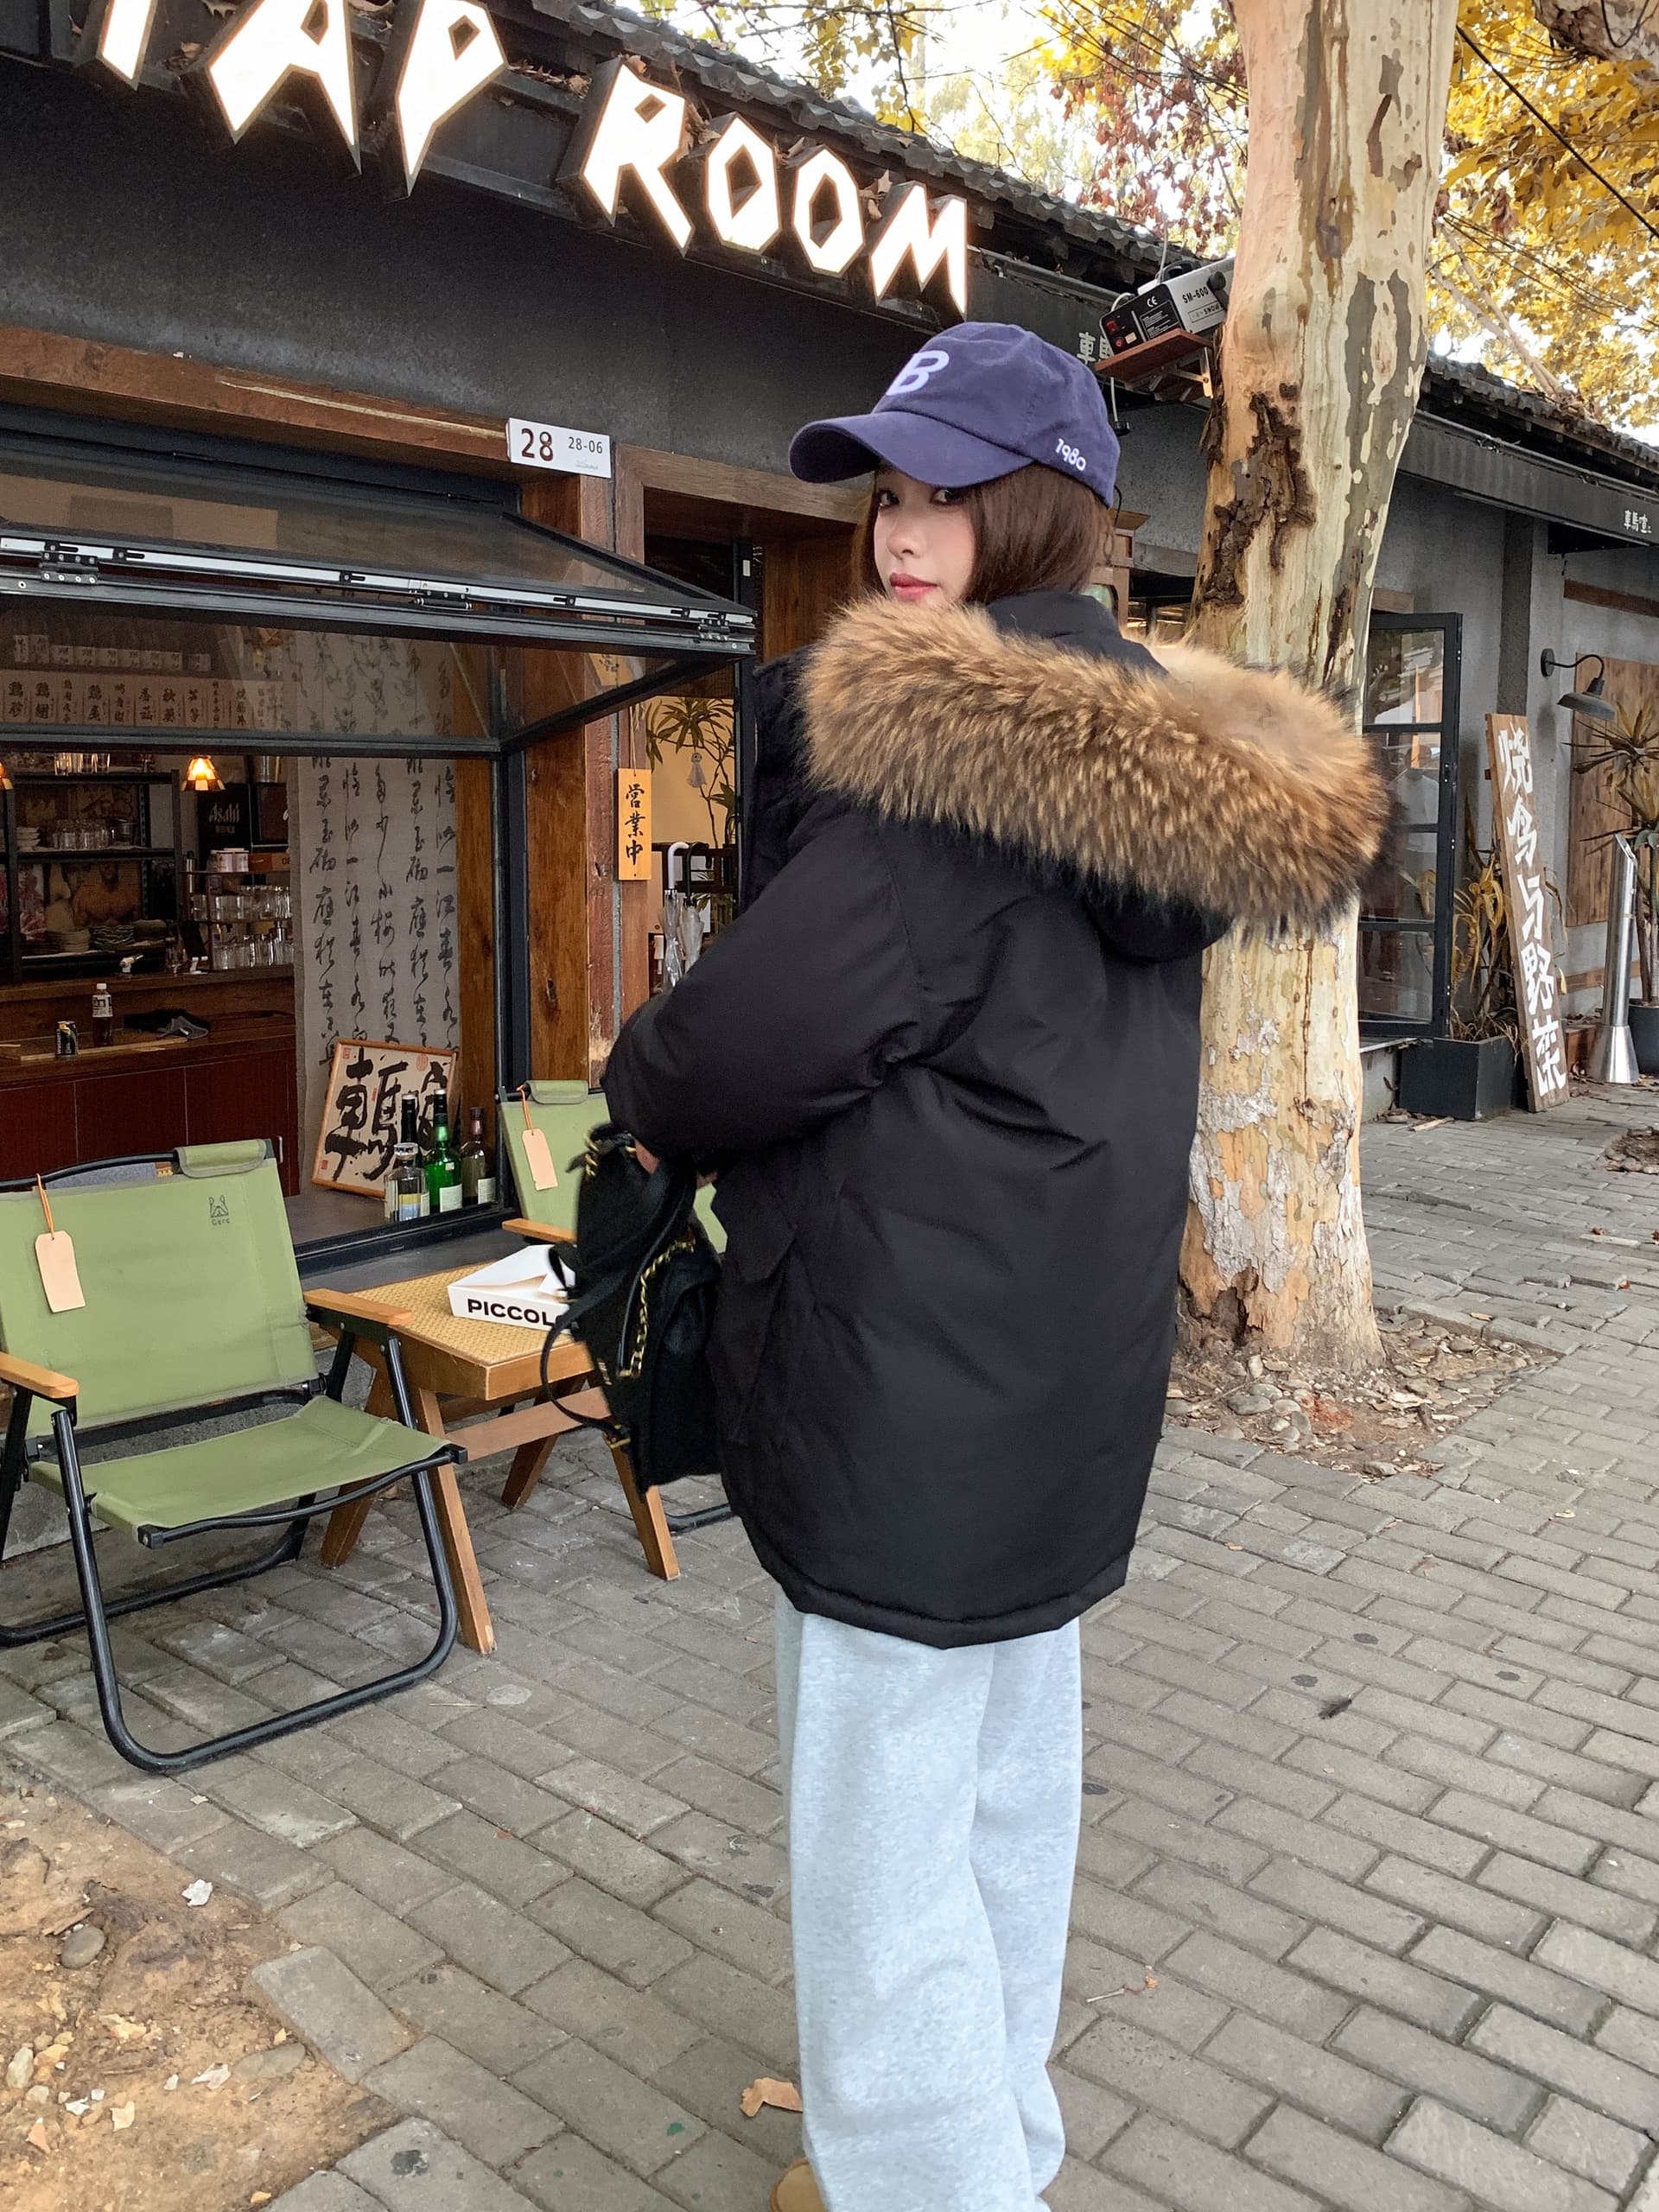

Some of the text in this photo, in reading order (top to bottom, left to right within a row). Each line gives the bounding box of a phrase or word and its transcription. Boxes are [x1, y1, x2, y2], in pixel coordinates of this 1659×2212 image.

[581, 62, 968, 323] ROOM
[1182, 285, 1210, 304] SM-600
[886, 349, 950, 397] B
[521, 428, 603, 461] 28 28-06
[1054, 438, 1086, 472] 1980
[208, 802, 240, 823] Asahi
[467, 1298, 554, 1327] PICCOL
